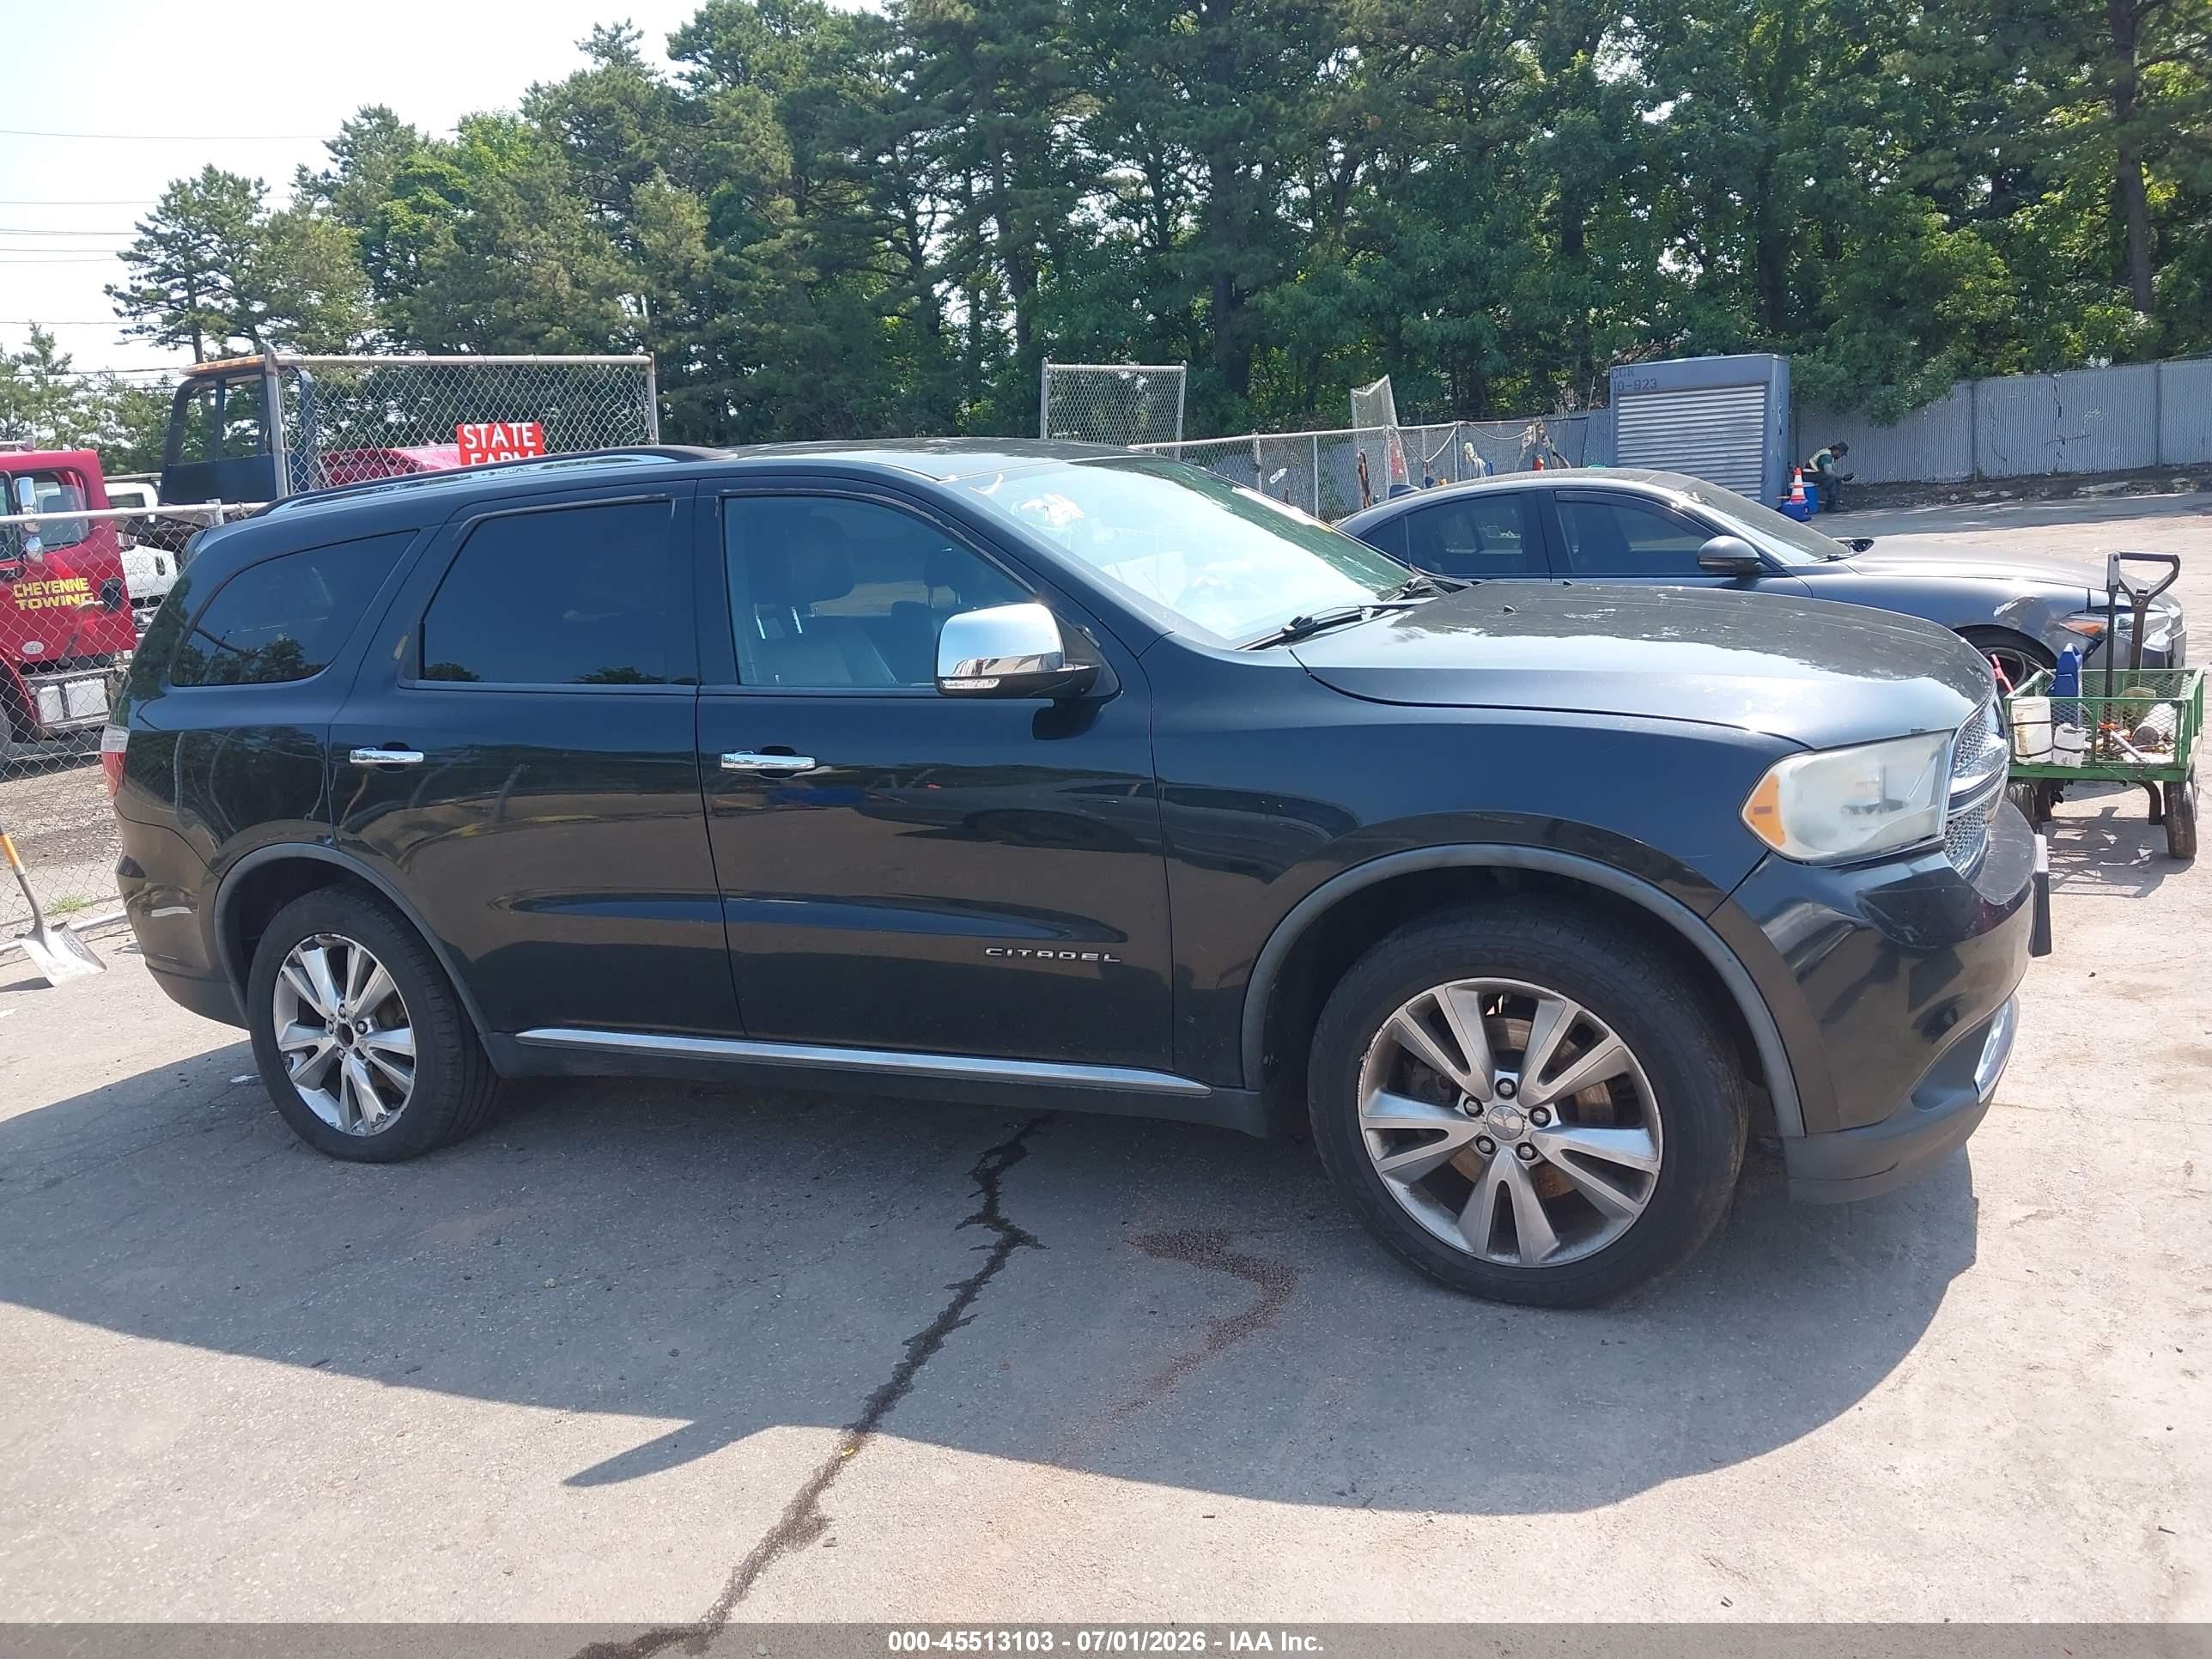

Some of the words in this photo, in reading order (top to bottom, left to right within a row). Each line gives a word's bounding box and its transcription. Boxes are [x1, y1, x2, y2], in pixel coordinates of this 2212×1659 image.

[464, 422, 537, 449] STATE
[13, 577, 90, 598] CHEYENNE
[15, 592, 94, 611] TOWING
[985, 947, 1121, 963] CITADEL
